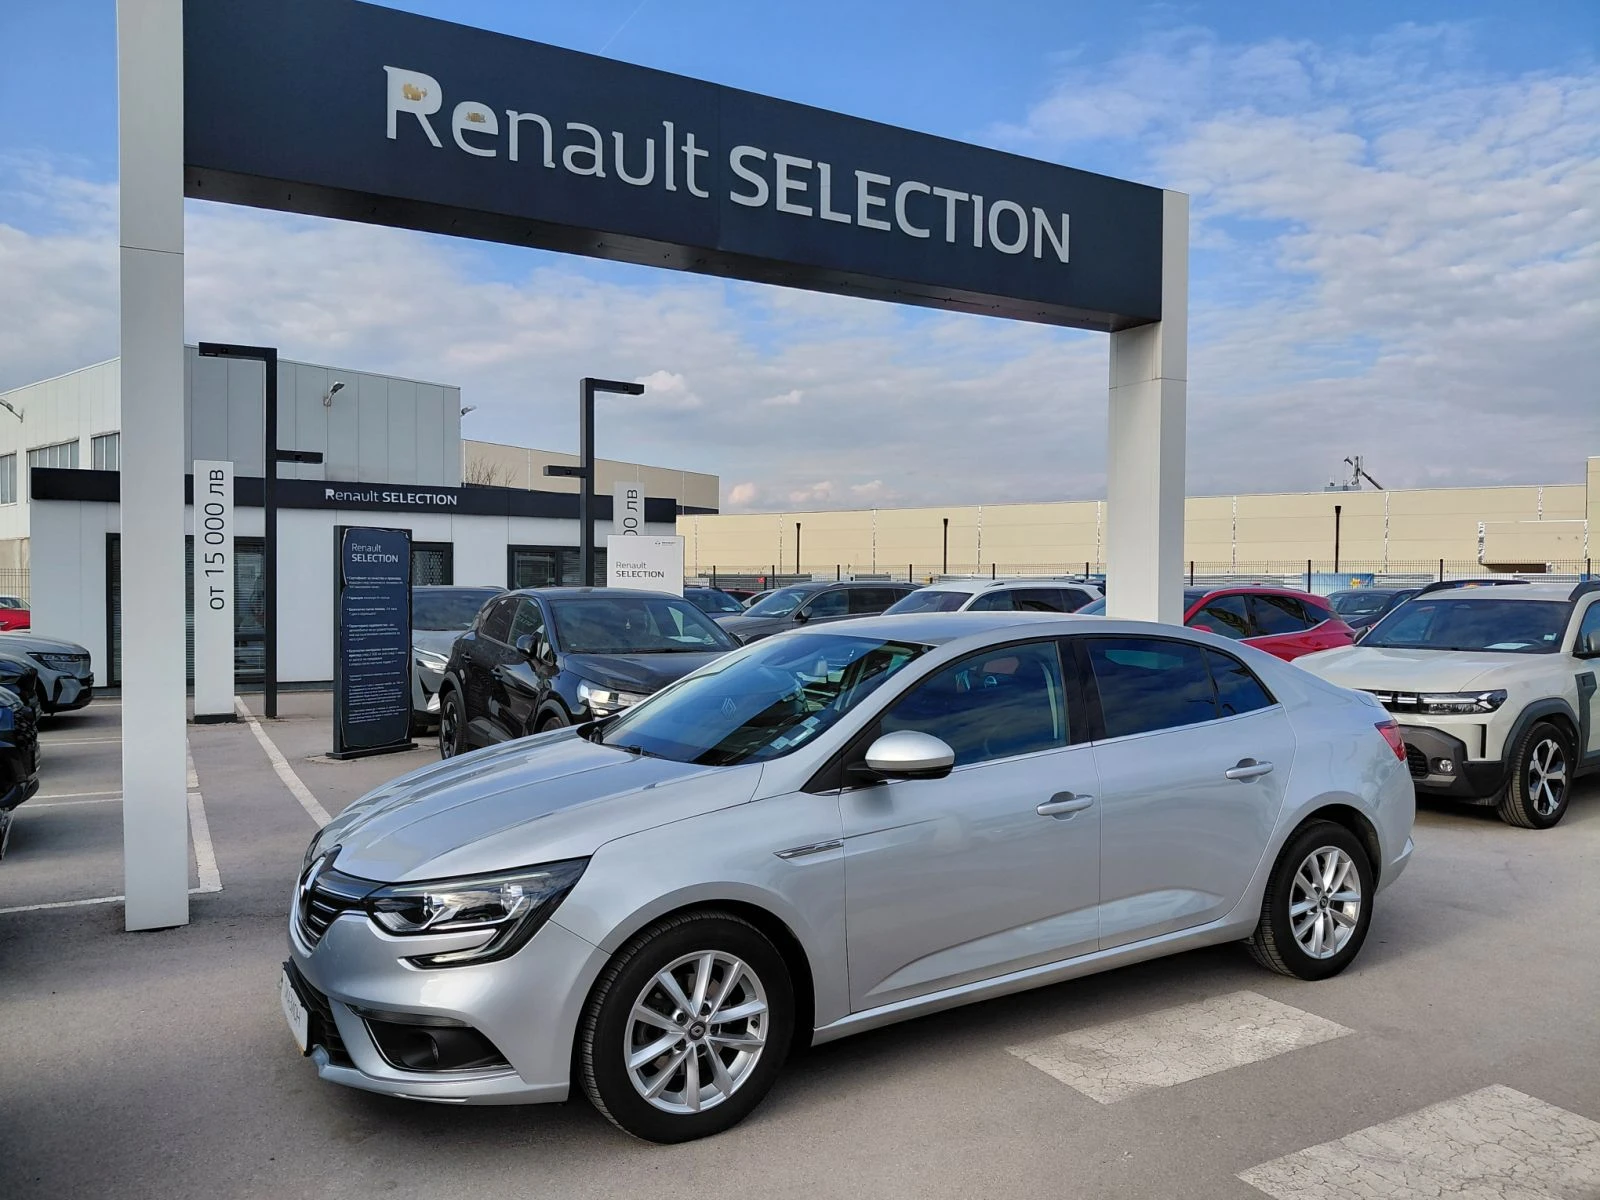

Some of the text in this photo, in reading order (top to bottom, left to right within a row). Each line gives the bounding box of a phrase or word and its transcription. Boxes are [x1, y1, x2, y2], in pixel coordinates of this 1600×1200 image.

[383, 65, 1070, 264] Renault SELECTION
[325, 488, 458, 506] Renault SELECTION
[204, 502, 225, 545] 000
[351, 542, 382, 553] Renault
[204, 552, 225, 577] 15
[351, 553, 399, 563] SELECTION
[615, 561, 647, 569] Renault
[615, 570, 665, 578] SELECTION
[209, 585, 225, 610] от
